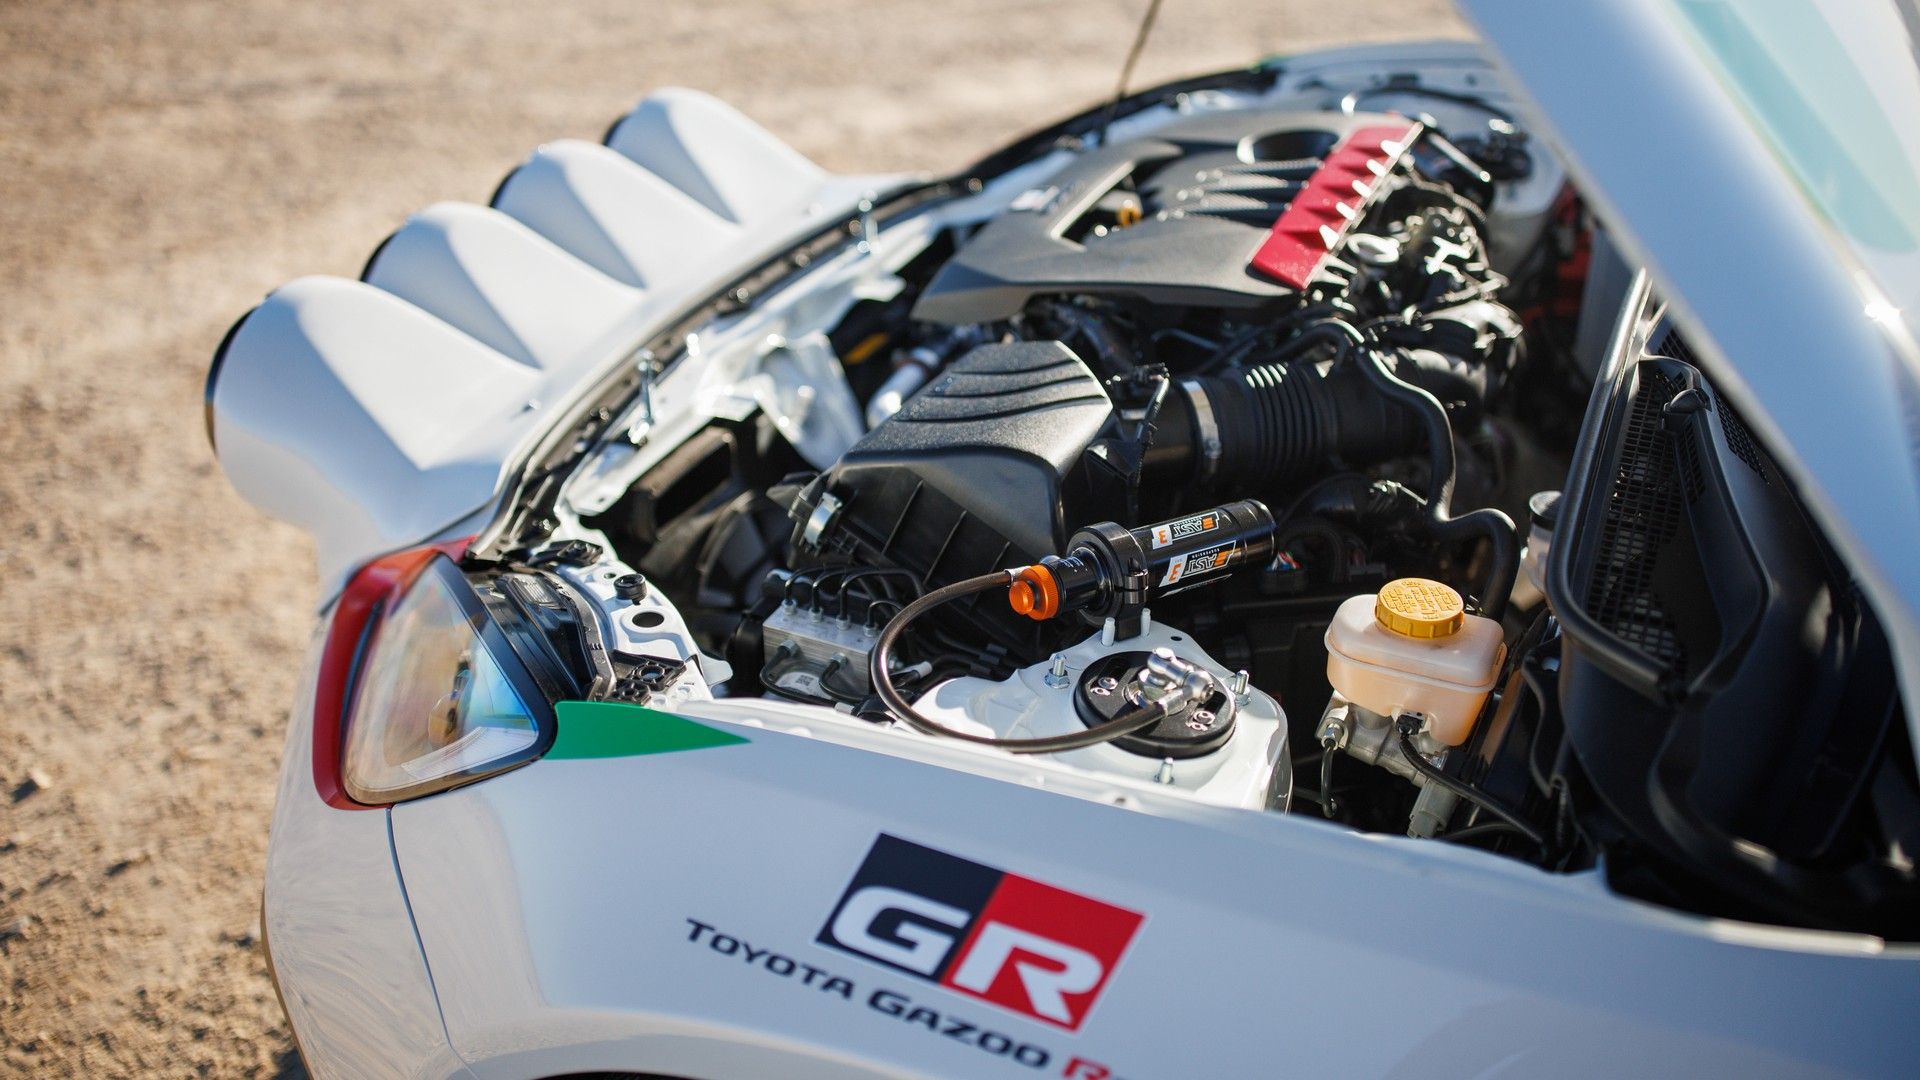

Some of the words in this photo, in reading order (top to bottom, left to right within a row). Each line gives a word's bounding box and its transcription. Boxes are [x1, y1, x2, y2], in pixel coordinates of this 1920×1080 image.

[1158, 528, 1168, 545] 3
[1173, 519, 1203, 537] AST
[1168, 563, 1182, 582] 3
[1184, 553, 1217, 575] AST
[832, 886, 1103, 1025] GR
[686, 918, 855, 1000] TOYOTA
[867, 989, 1051, 1070] GAZOO
